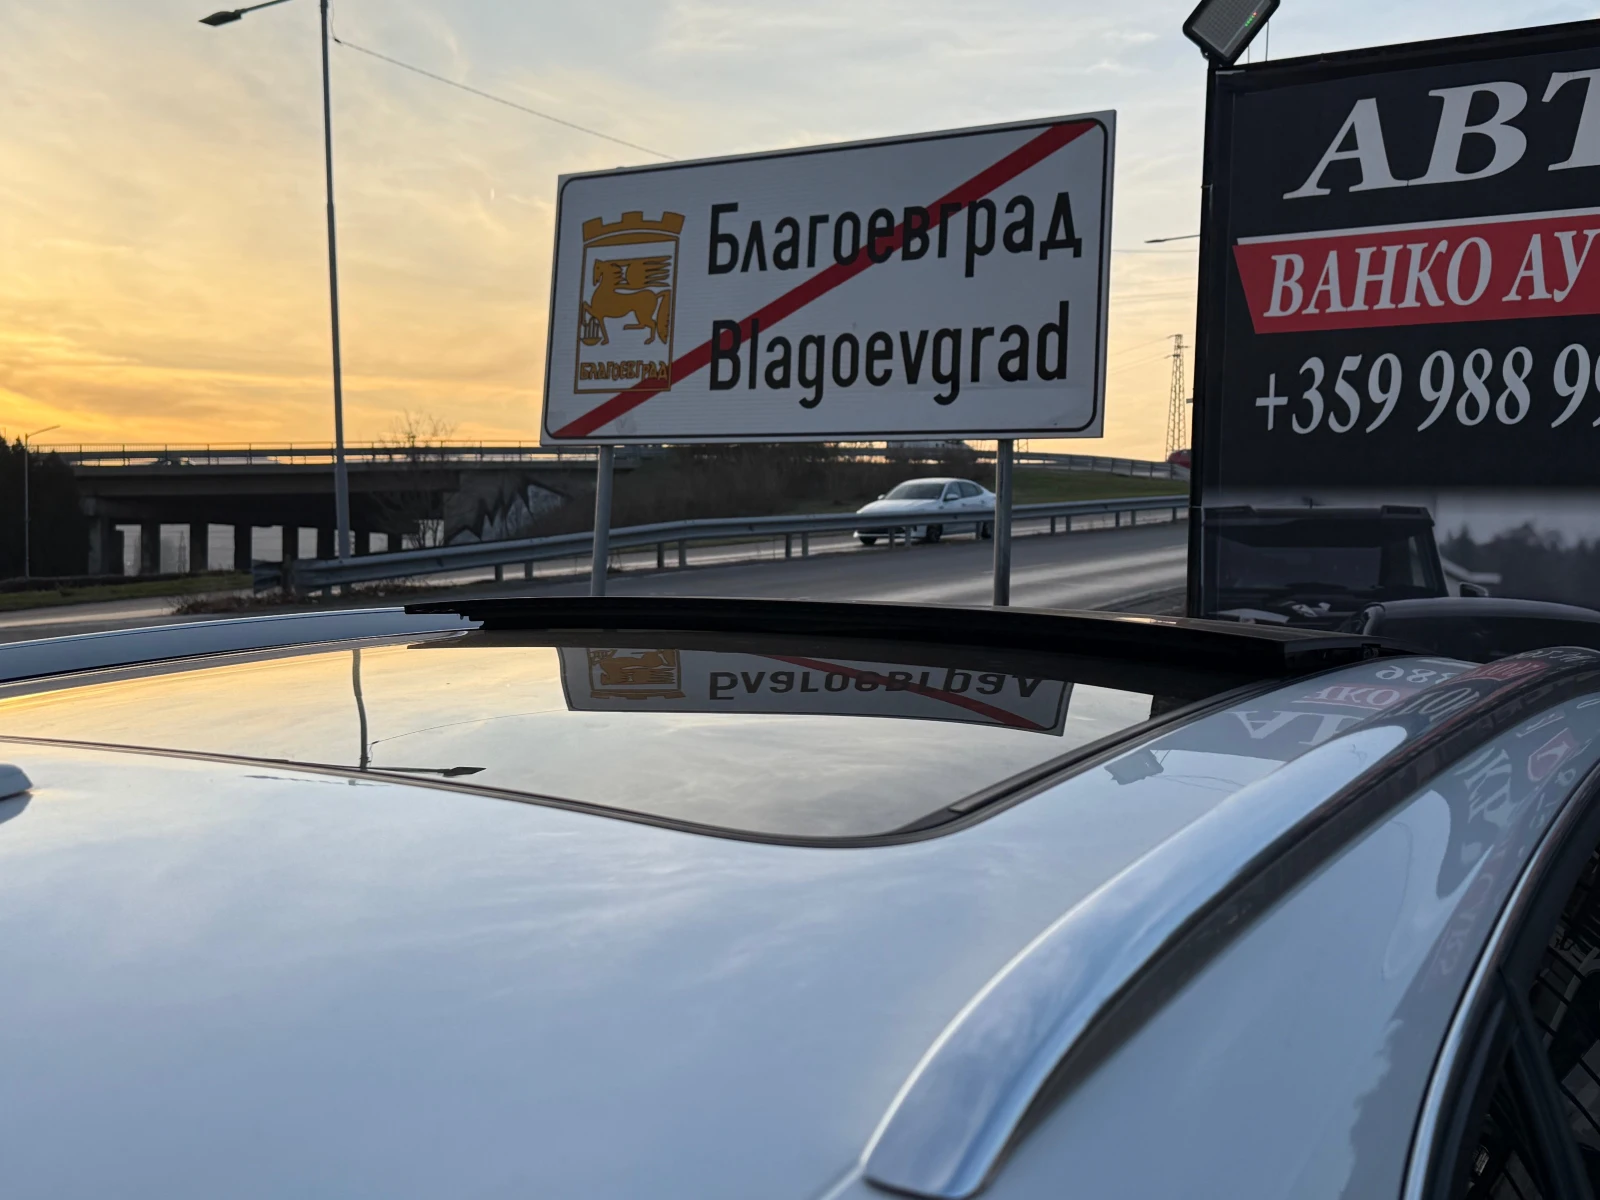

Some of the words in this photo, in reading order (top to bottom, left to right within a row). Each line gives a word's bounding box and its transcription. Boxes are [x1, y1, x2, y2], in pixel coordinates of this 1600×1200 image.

[707, 191, 1083, 278] Благоевград
[1262, 236, 1493, 318] ВАНКО
[1501, 228, 1600, 303] АУ
[579, 360, 670, 381] БЛАГОЕВГРАД
[708, 300, 1070, 409] Blagoevgrad
[1254, 351, 1403, 435] +359
[1416, 345, 1534, 432] 988
[1550, 342, 1600, 429] 9
